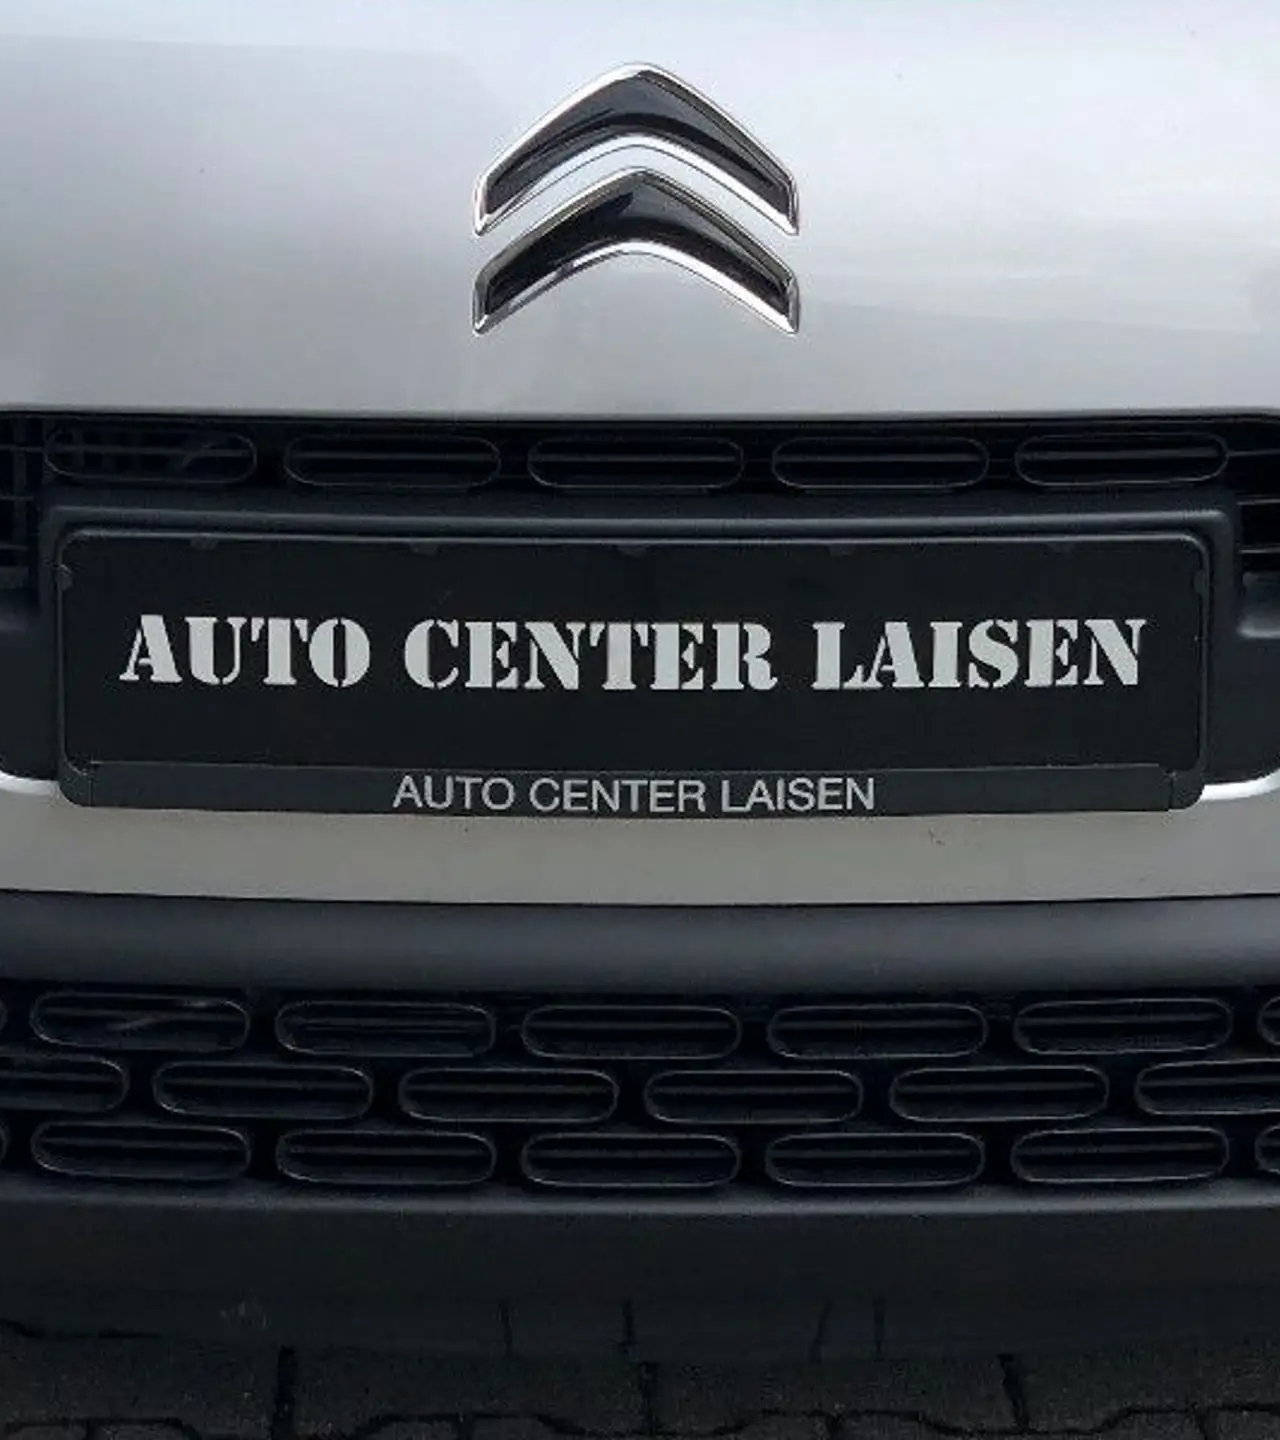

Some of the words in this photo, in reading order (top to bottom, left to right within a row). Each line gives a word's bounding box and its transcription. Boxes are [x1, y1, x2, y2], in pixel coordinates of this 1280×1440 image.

[119, 614, 371, 689] AUTO
[403, 618, 779, 692] CENTER
[810, 617, 1148, 691] LAISEN
[392, 775, 516, 810] AUTO
[529, 777, 706, 813] CENTER
[721, 777, 876, 813] LAISEN
